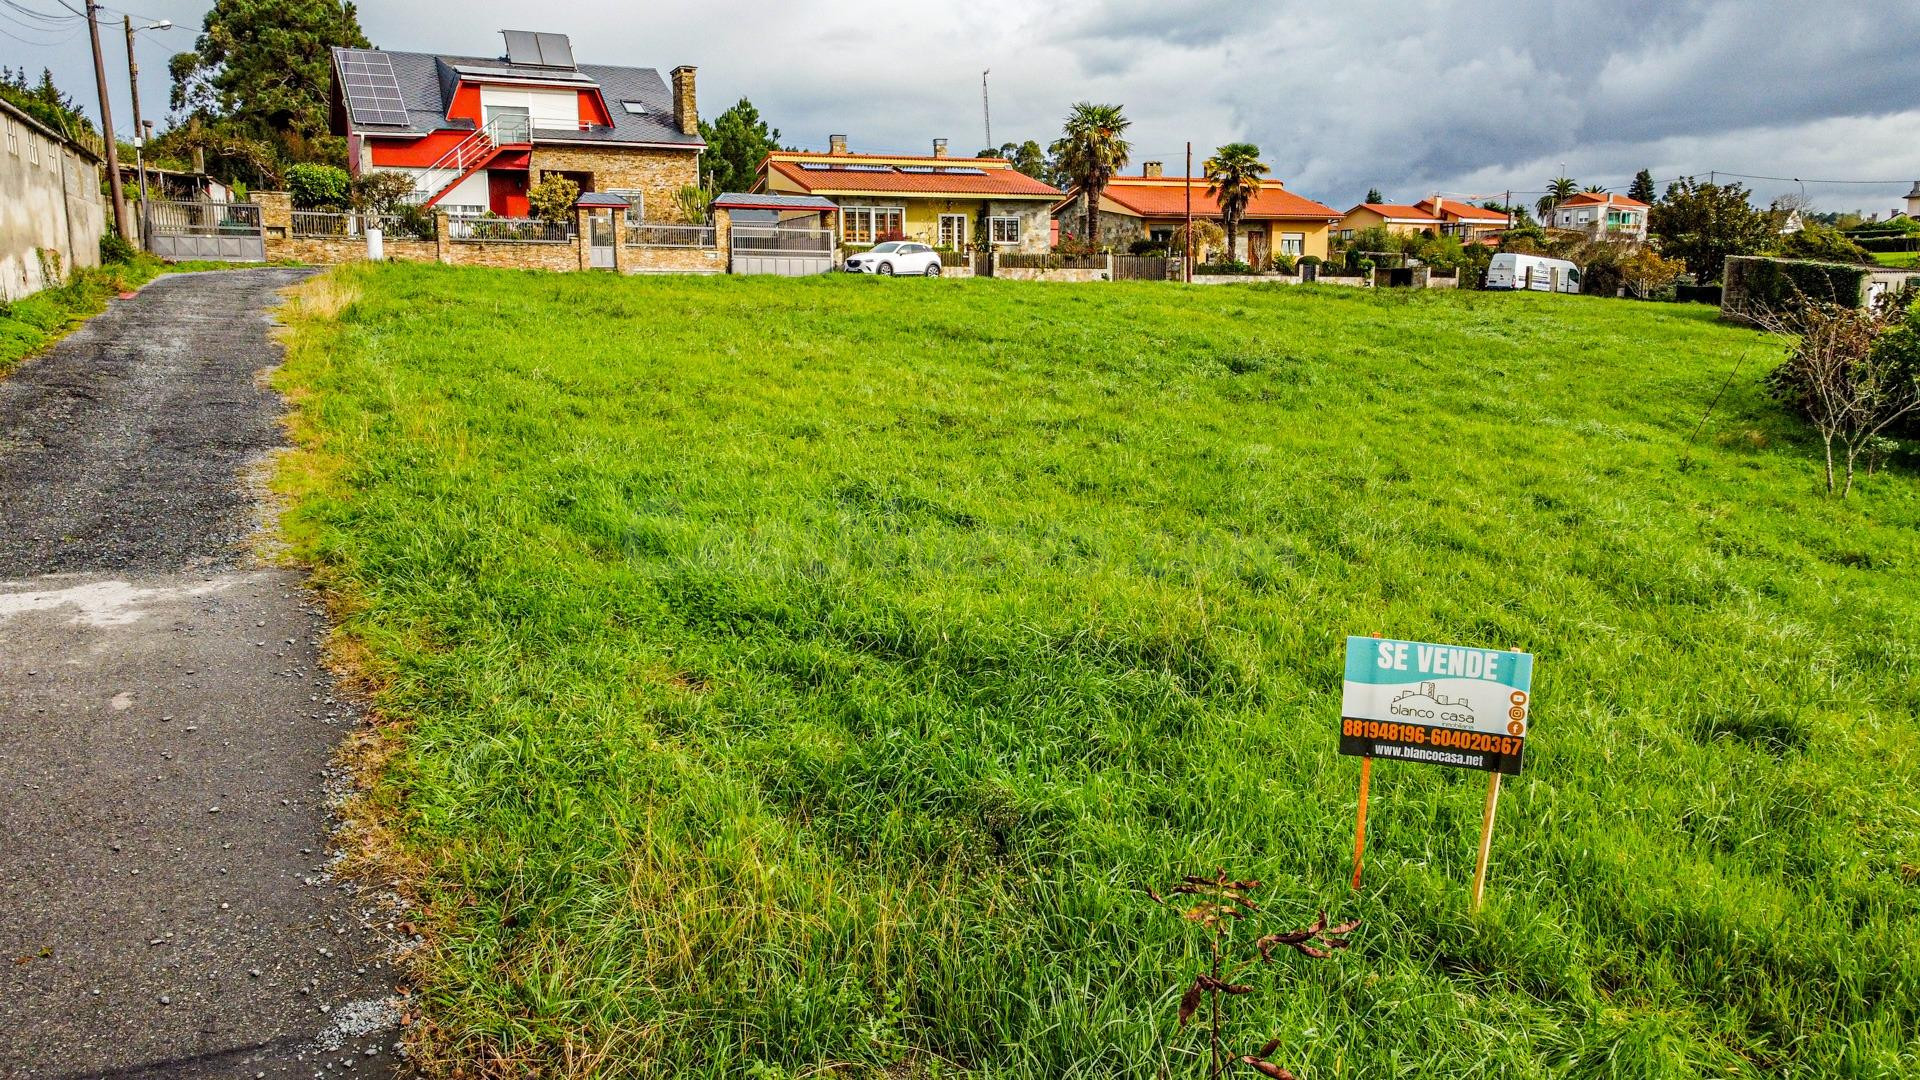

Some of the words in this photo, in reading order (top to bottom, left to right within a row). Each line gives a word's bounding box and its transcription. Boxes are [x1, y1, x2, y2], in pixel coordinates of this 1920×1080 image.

[1377, 641, 1409, 671] SE
[1417, 645, 1499, 680] VENDE
[1390, 703, 1435, 719] blanco
[1441, 711, 1475, 724] casa
[1343, 719, 1522, 756] 881948196-604020367
[1375, 744, 1483, 767] www.blancocasa.net
